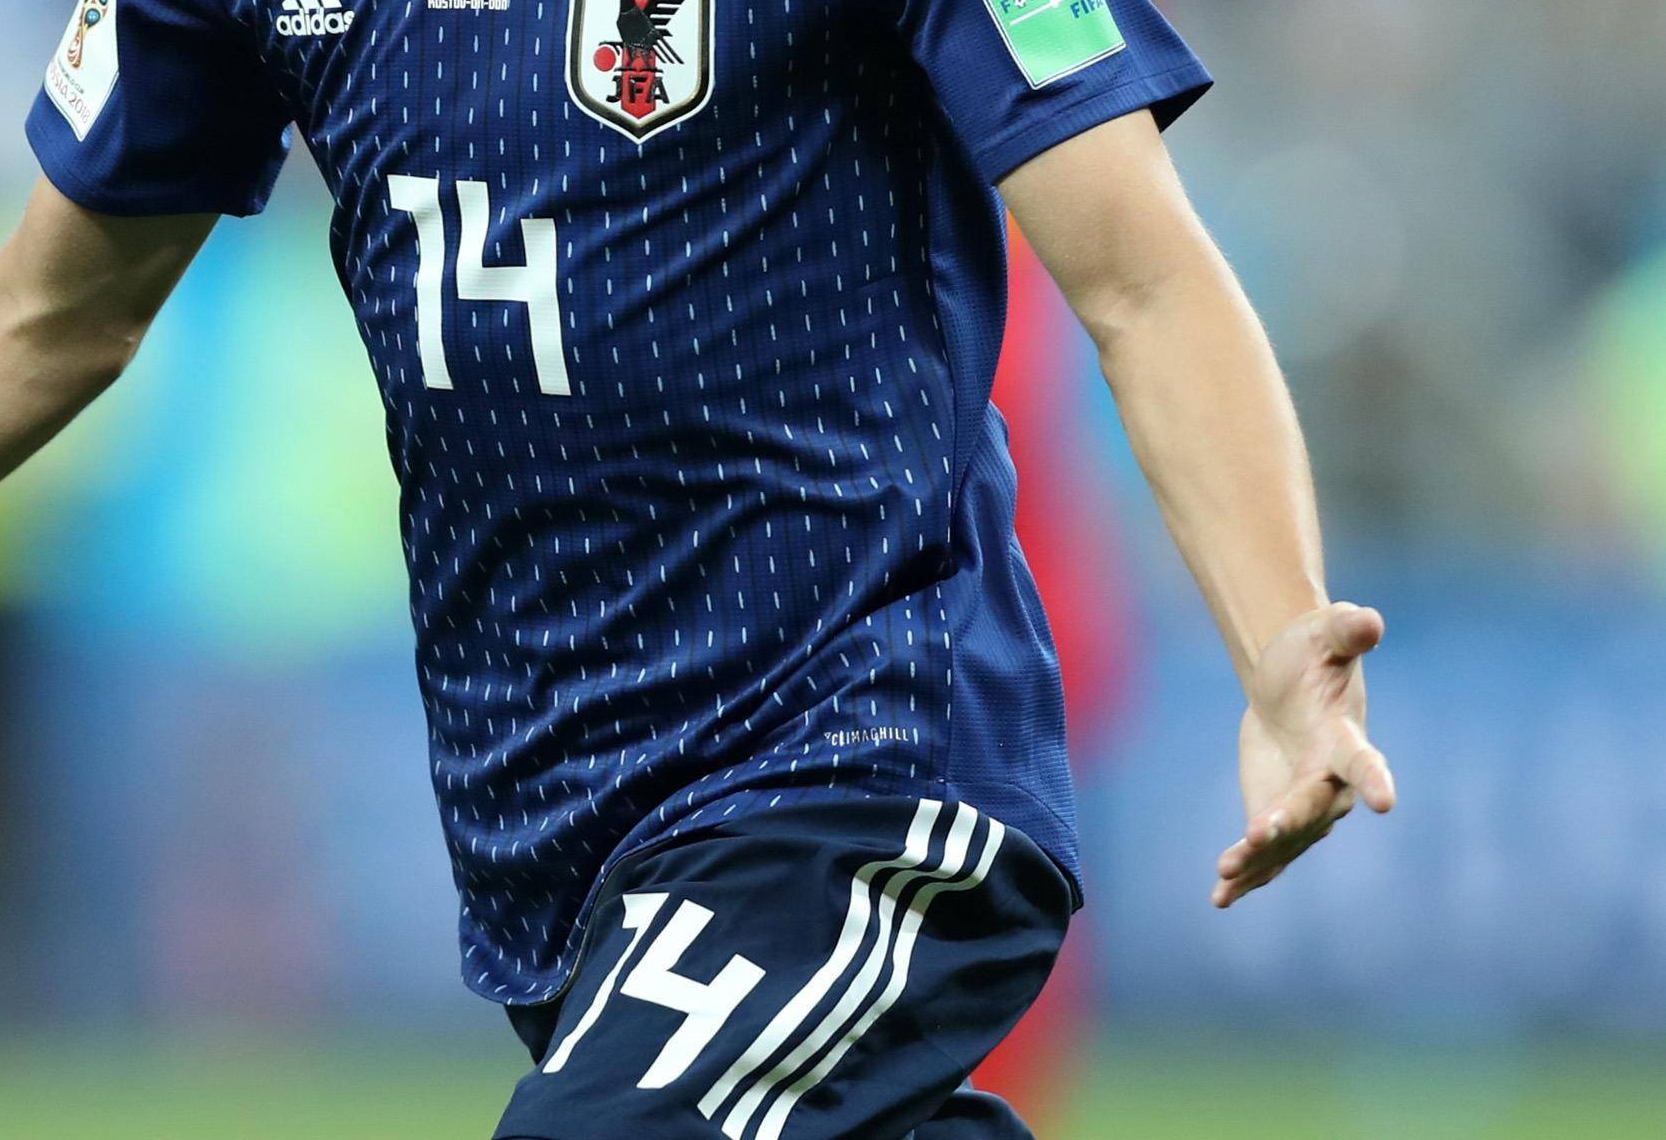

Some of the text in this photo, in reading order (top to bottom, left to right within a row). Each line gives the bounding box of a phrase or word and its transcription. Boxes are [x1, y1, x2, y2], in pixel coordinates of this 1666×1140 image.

[276, 7, 355, 36] adidas
[605, 75, 670, 104] JFA
[68, 91, 91, 124] 2018
[387, 174, 572, 397] 14
[542, 892, 767, 1089] 14
